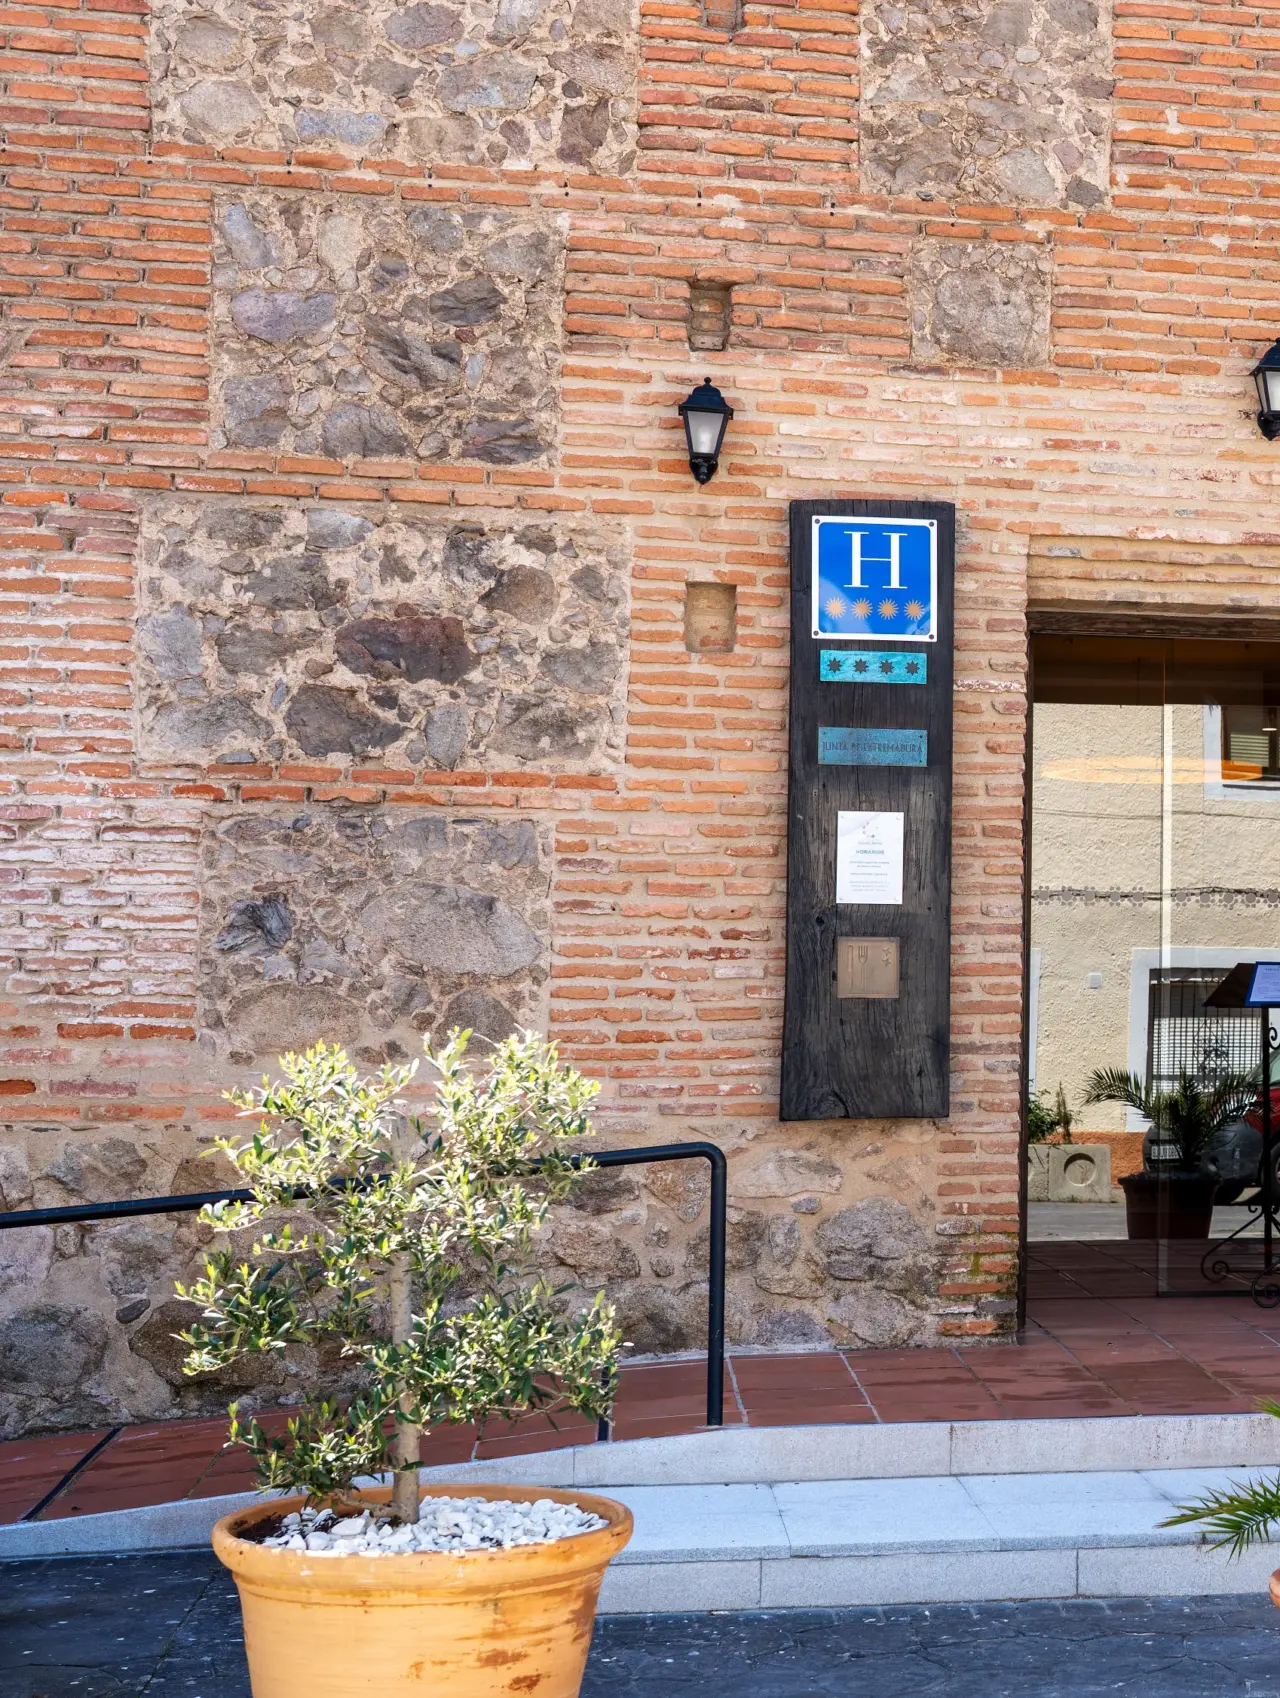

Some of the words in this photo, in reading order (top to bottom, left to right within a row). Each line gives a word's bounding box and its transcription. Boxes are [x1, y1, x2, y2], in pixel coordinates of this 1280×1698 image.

[843, 531, 908, 589] H
[822, 741, 849, 752] JUNTA
[851, 742, 862, 752] DE
[863, 743, 923, 753] EXTREMADURA
